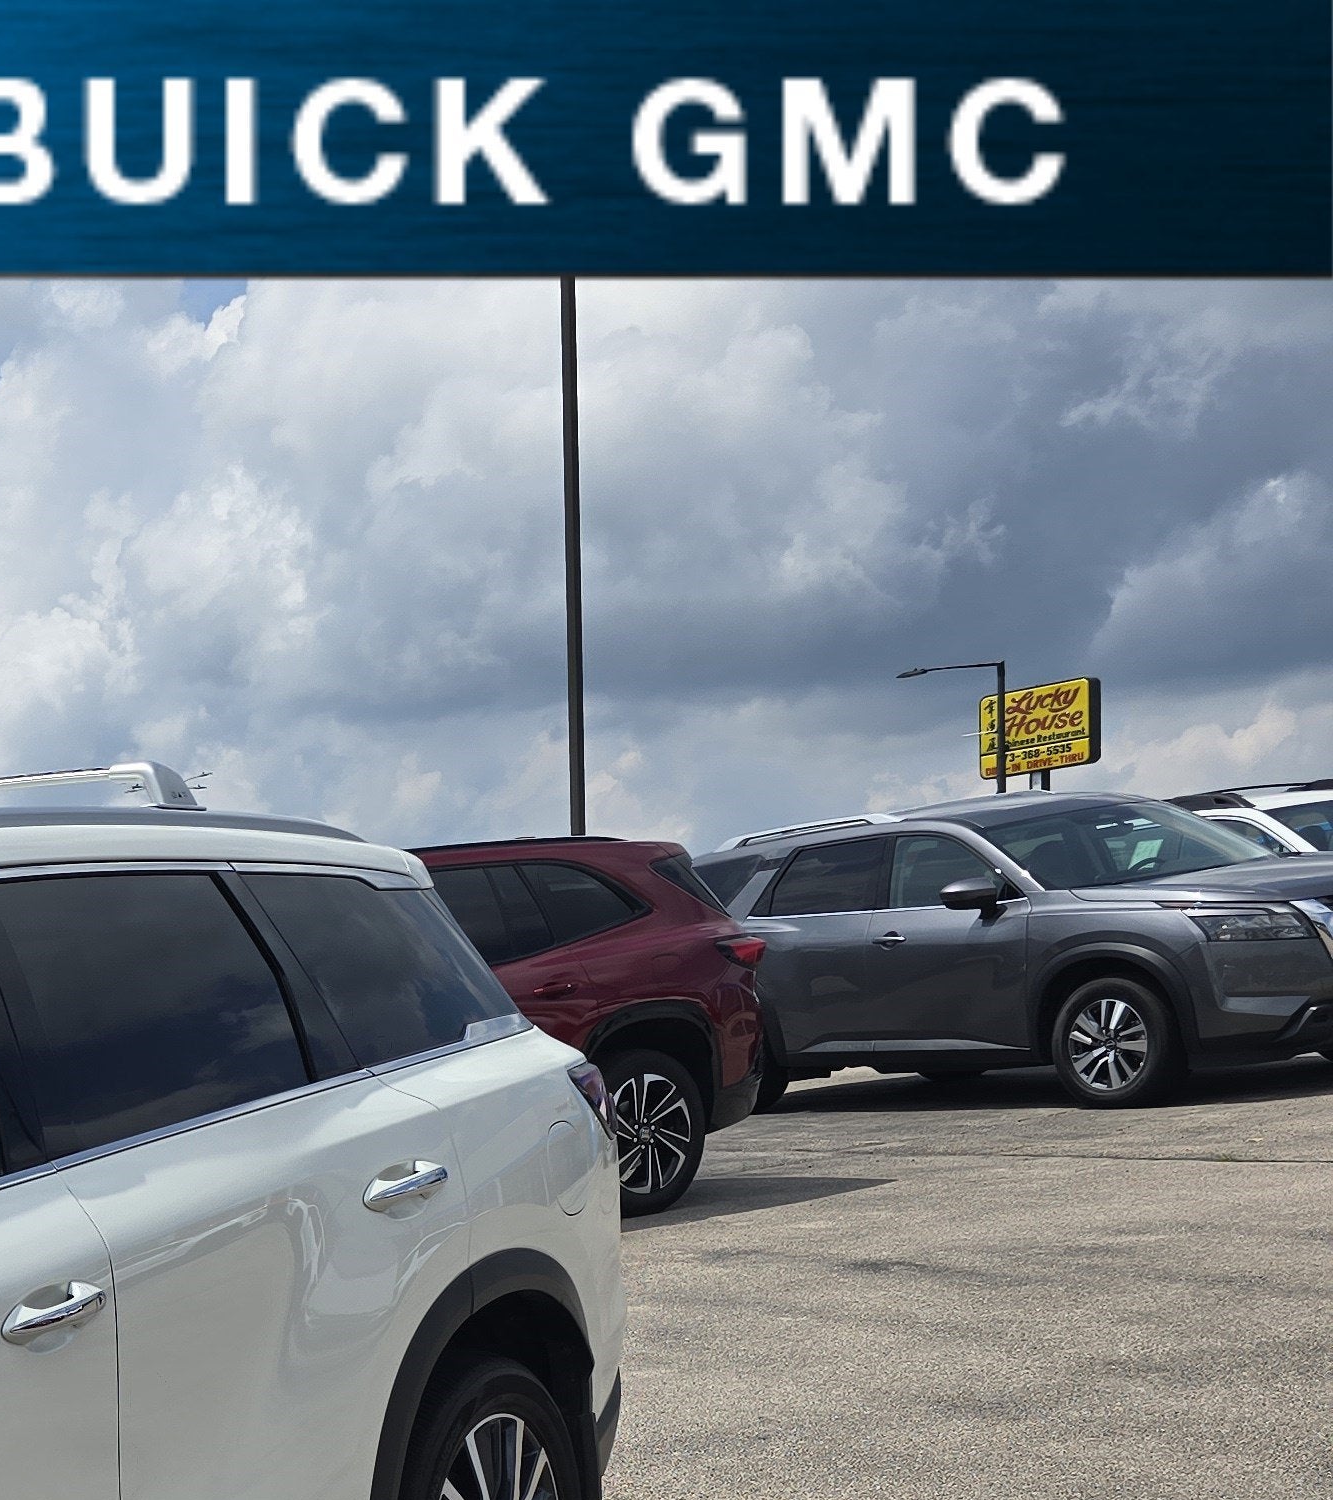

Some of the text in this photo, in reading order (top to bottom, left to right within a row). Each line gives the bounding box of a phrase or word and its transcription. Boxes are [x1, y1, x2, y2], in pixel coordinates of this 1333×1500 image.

[1006, 686, 1081, 715] Lucky
[1005, 709, 1084, 738] House
[1005, 727, 1086, 748] hinese Restaurant
[1027, 751, 1085, 769] DRIVE-THRU
